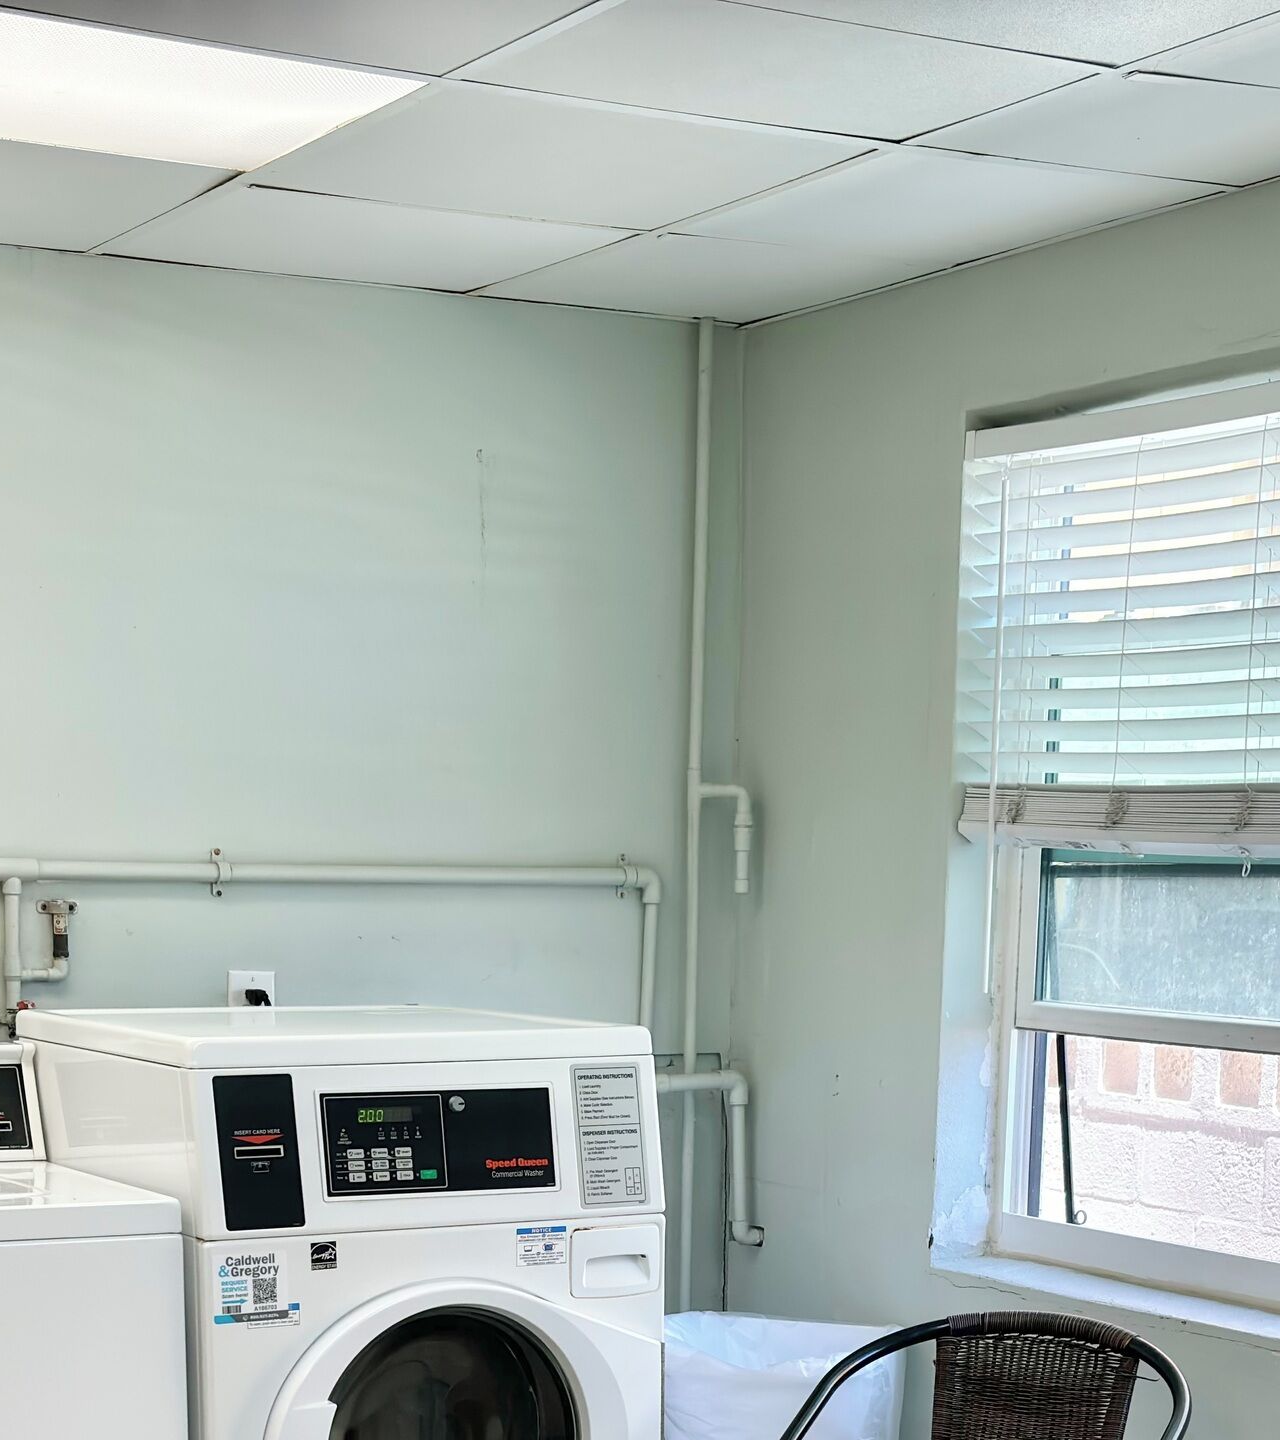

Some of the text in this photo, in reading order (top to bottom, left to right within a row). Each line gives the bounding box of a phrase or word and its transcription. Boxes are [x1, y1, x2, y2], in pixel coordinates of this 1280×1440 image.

[486, 1158, 549, 1169] Speed Queen
[492, 1169, 544, 1178] Commercial Washer
[226, 1253, 275, 1267] Caldwell
